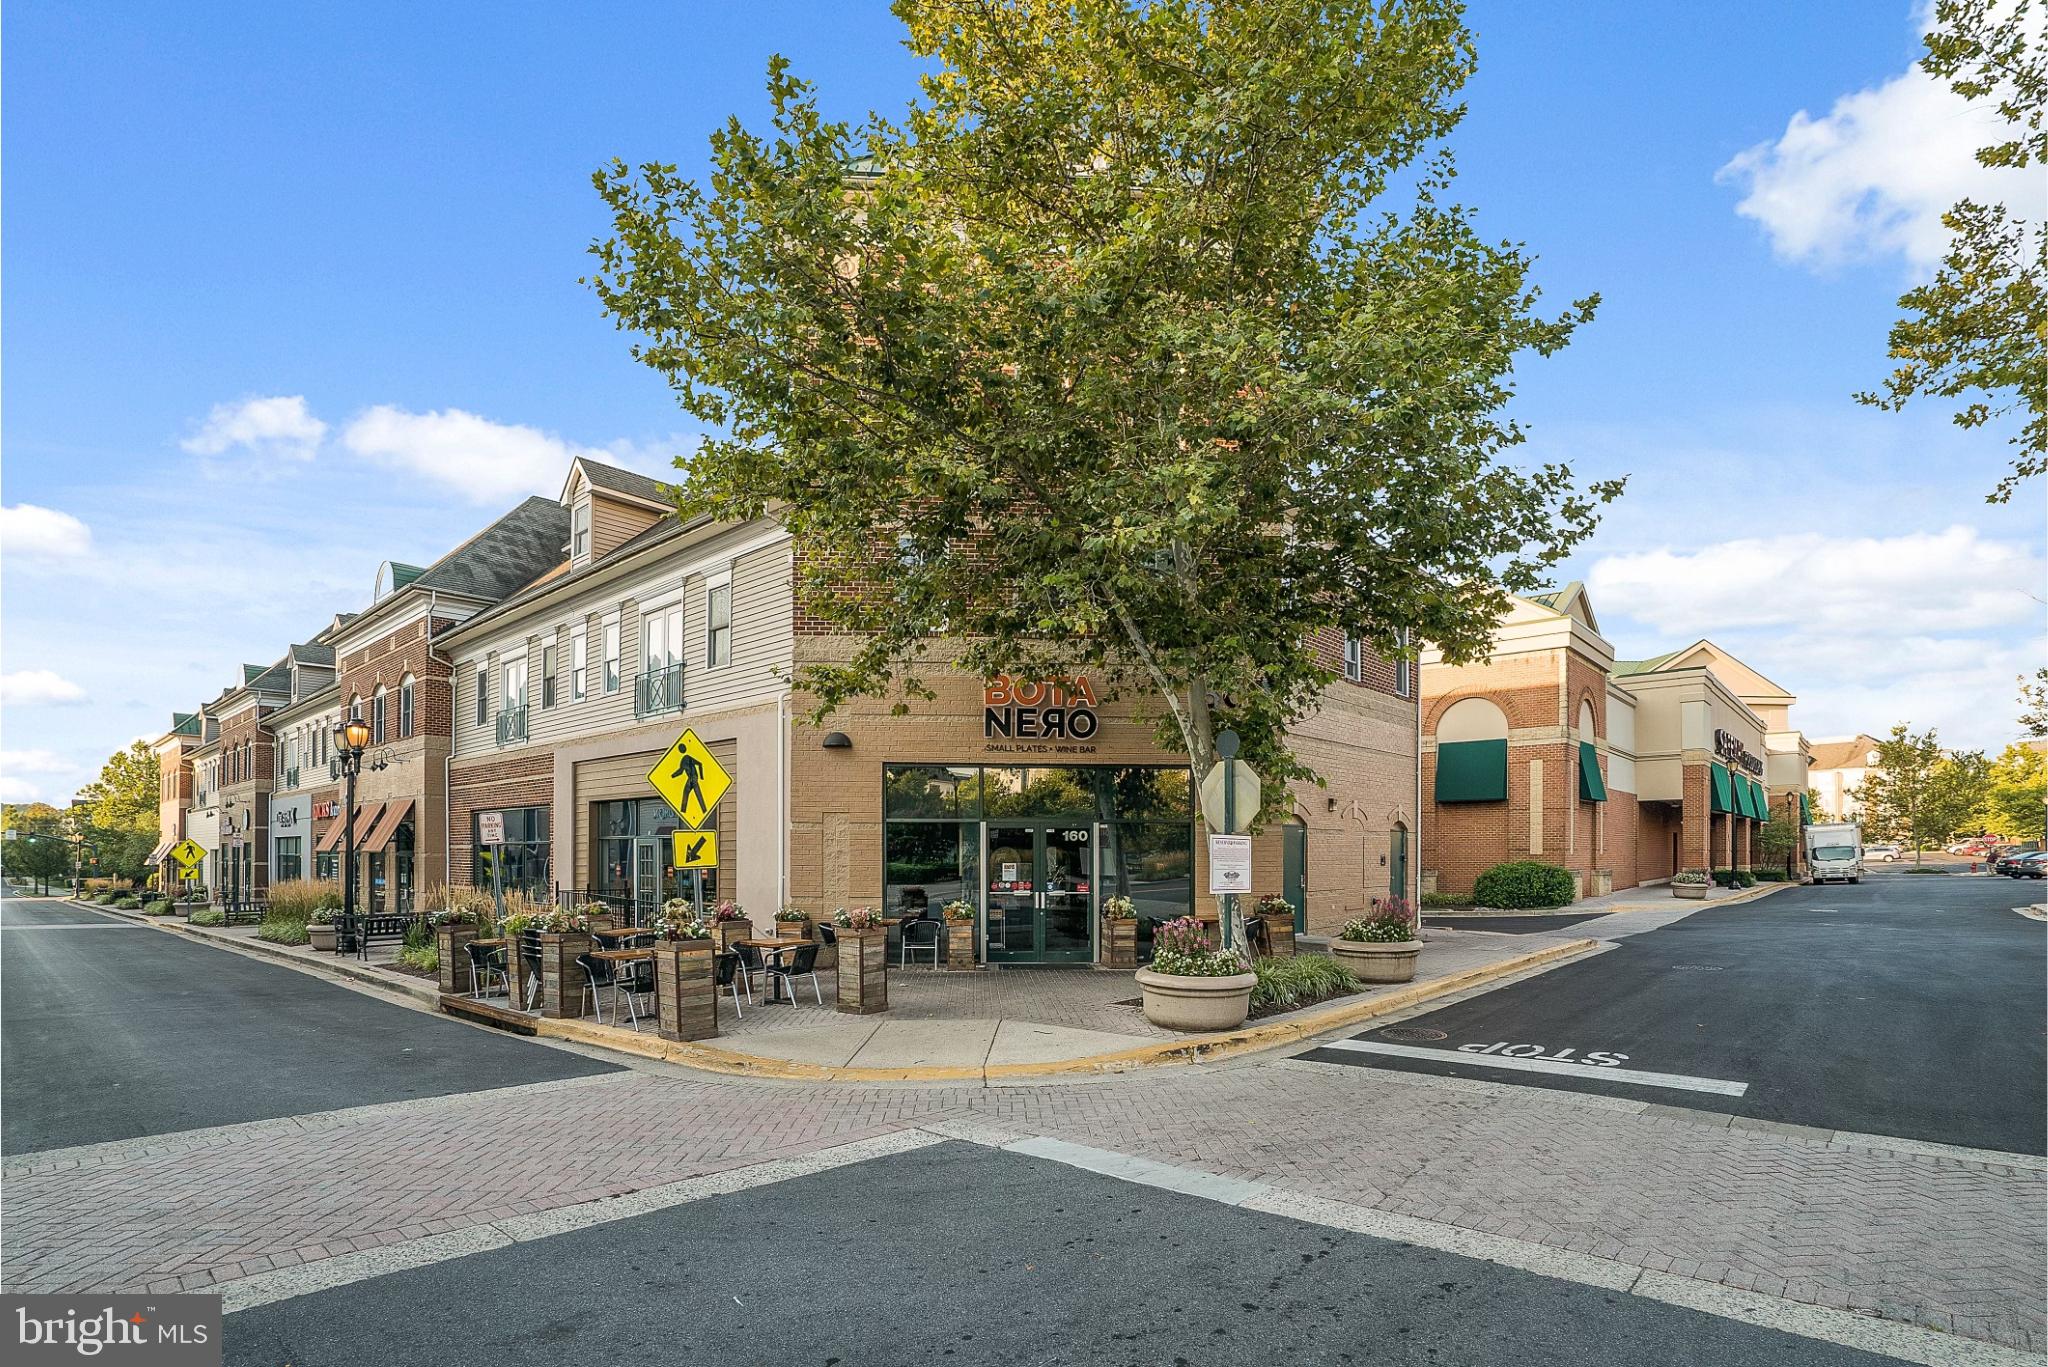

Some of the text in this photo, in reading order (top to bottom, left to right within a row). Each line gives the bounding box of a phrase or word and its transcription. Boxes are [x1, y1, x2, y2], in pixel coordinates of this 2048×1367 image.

[984, 674, 1098, 708] BOTA
[984, 707, 1099, 740] NERO
[985, 744, 1097, 754] SMALL PLATES WINE BAR
[1062, 830, 1088, 841] 160
[1457, 1041, 1630, 1067] STOP
